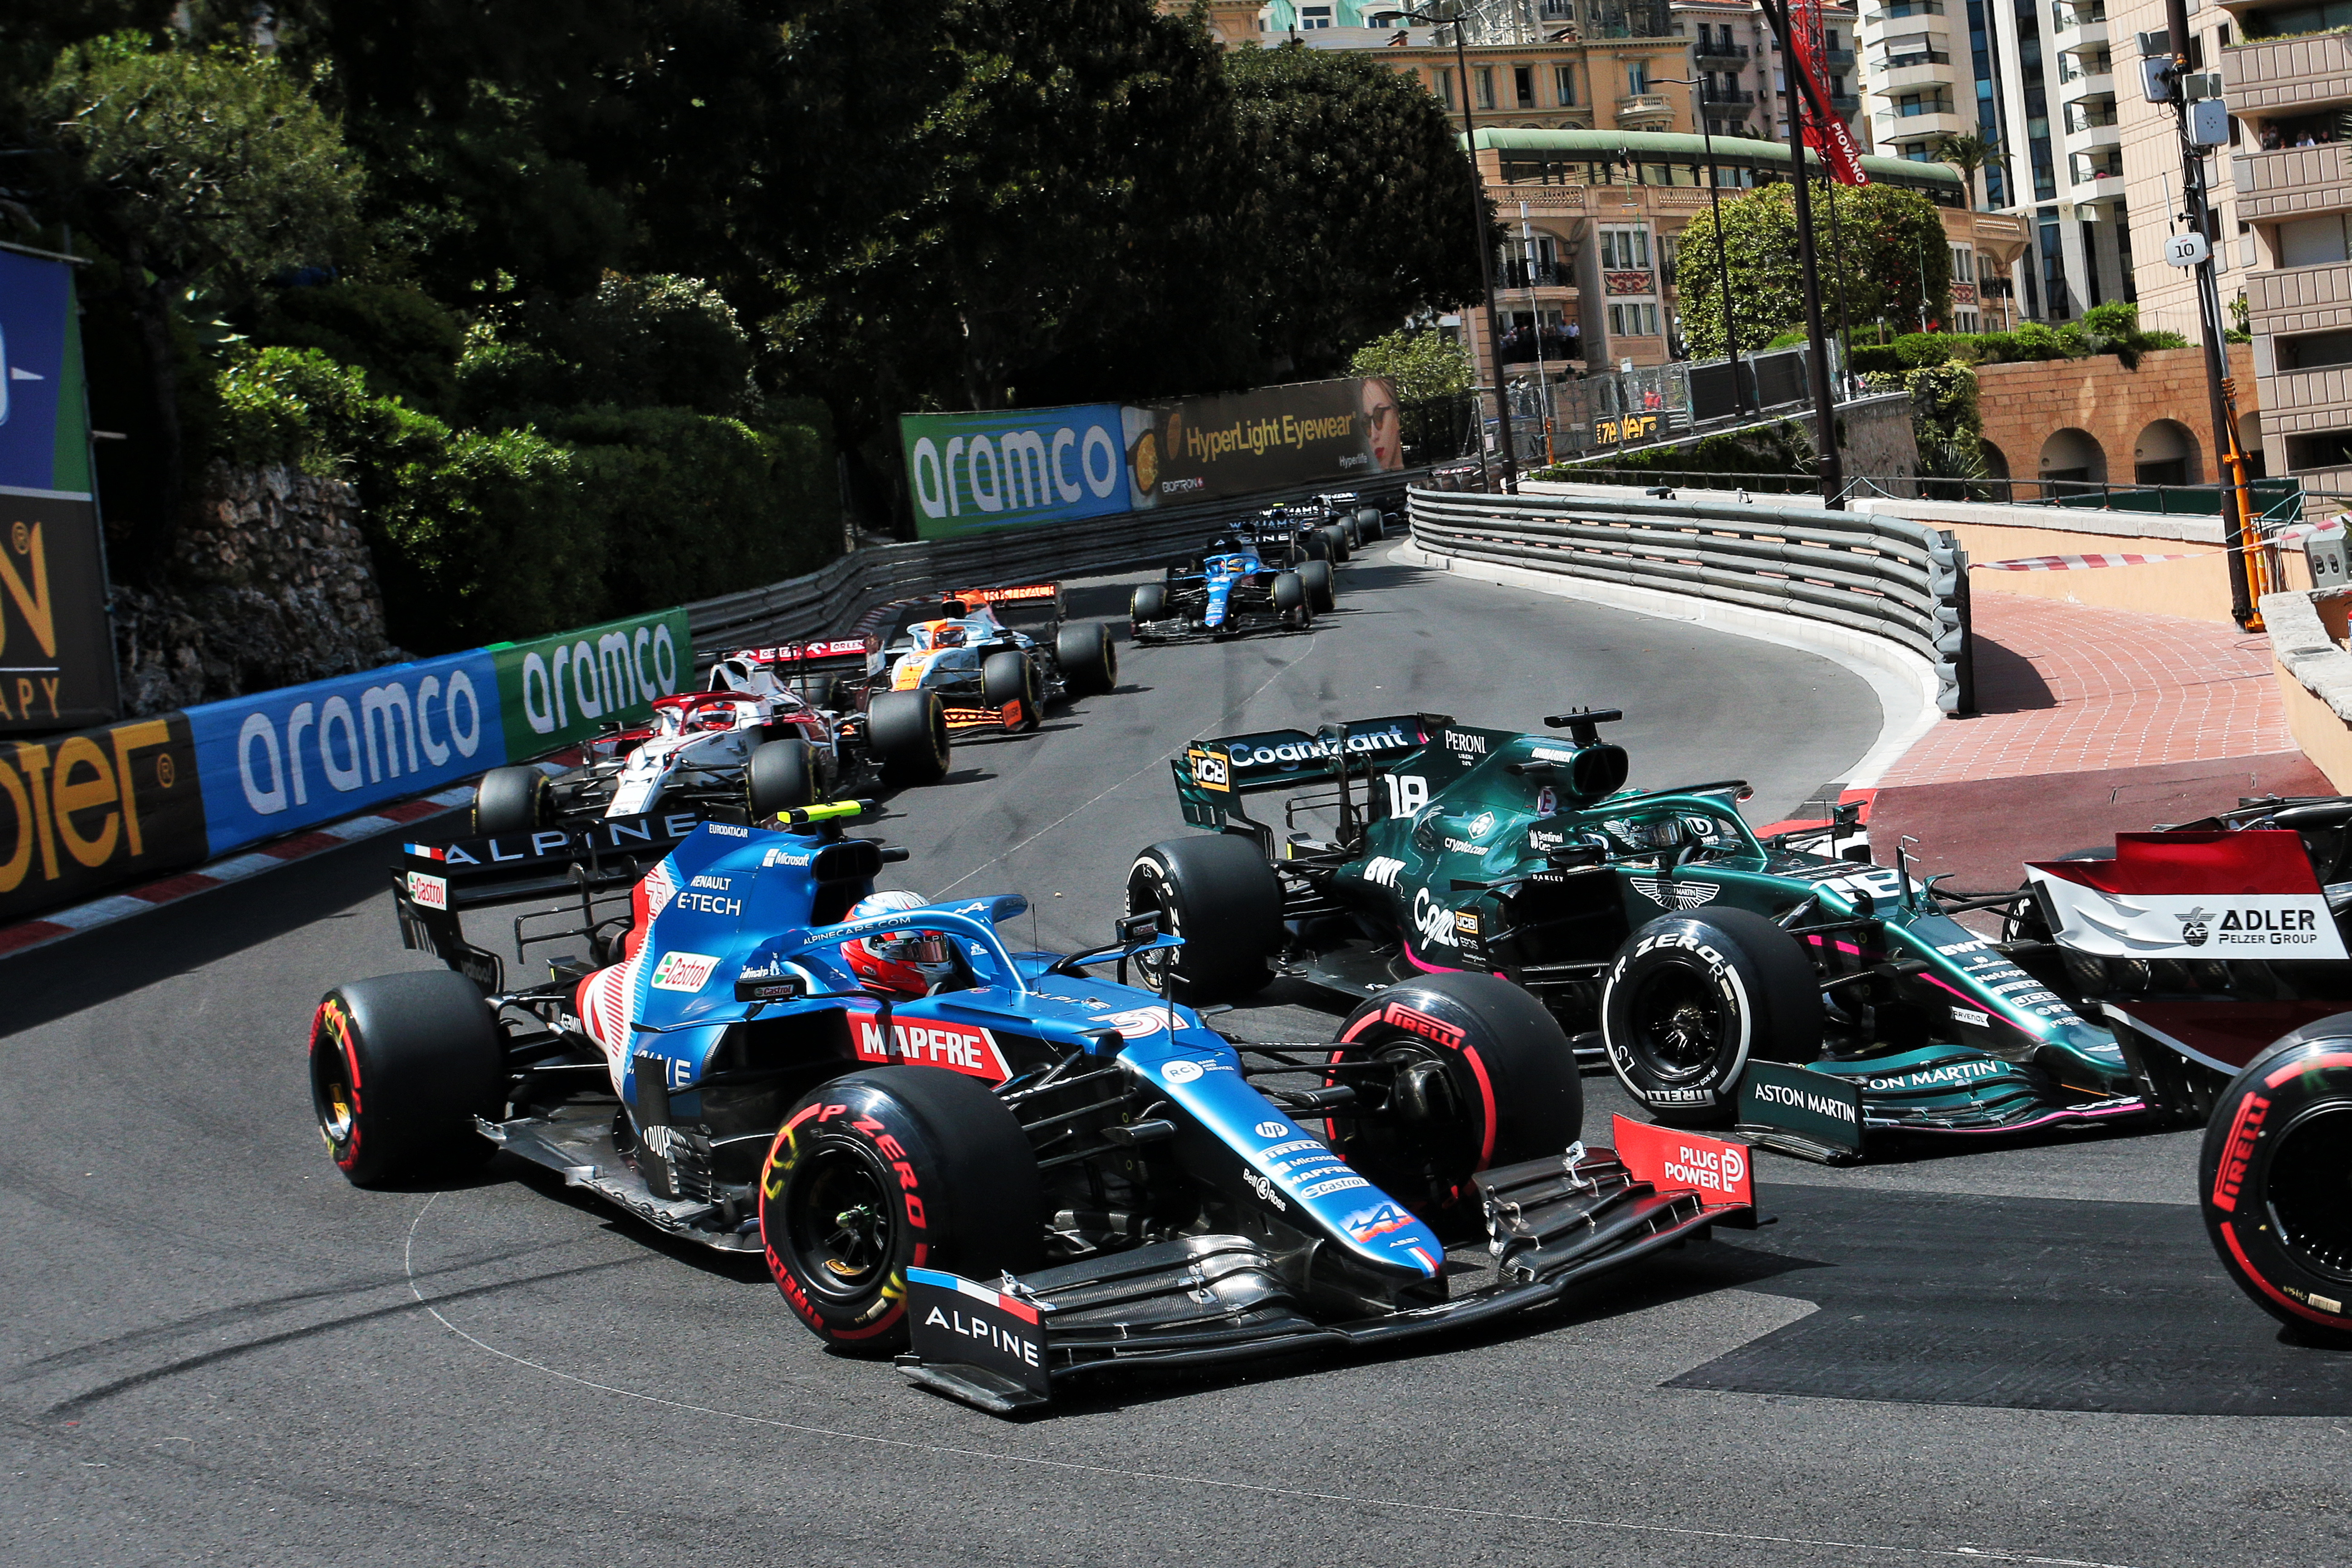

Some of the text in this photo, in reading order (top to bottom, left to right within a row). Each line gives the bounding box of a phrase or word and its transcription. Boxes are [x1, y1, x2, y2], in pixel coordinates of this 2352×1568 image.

[1832, 122, 1866, 183] PIOVANO
[2176, 243, 2194, 258] 10
[1186, 414, 1352, 462] HyperLight Eyewear
[914, 425, 1116, 518] aramco
[523, 623, 676, 734] aramco
[238, 670, 479, 815] aramco
[1229, 725, 1408, 770] Cognizant
[1445, 730, 1487, 754] PERONI
[1531, 746, 1572, 763] BOMBARDIER
[1194, 758, 1226, 784] JCB
[1384, 774, 1429, 819] 18
[446, 815, 698, 864] ALPINE
[708, 823, 749, 838] EURODATACAR
[1538, 831, 1563, 843] Sentinel
[774, 853, 809, 867] Microsoft
[1444, 837, 1490, 857] crypto.com
[690, 875, 731, 891] RENAULT
[1364, 856, 1406, 888] BWT
[1532, 874, 1563, 882] OAKLEY
[416, 879, 444, 905] Castrol
[677, 892, 741, 916] E-TECH
[1676, 887, 1696, 897] MARTIN
[804, 916, 911, 946] ALPINECARS.COM
[1457, 916, 1476, 930] JCB
[2219, 910, 2317, 930] ADLER
[1635, 933, 1724, 964] ZERO
[1935, 940, 1988, 956] BWT
[666, 956, 709, 987] Castrol
[1975, 969, 2028, 984] NetApp
[763, 985, 792, 995] Castrol
[2047, 1004, 2073, 1013] IFS
[1086, 1005, 1191, 1040] 31
[1384, 1002, 1466, 1050] PIRELLI
[861, 1022, 983, 1069] MAPFRE
[1911, 1060, 1998, 1086] MARTIN
[1646, 1089, 1716, 1108] PIRELLI
[1754, 1082, 1856, 1125] ASTON MARTIN
[1260, 1122, 1282, 1138] hp
[1680, 1146, 1719, 1171] PLUG
[2212, 1091, 2271, 1212] PIRELLI
[818, 1104, 926, 1229] P ZERO
[1286, 1166, 1357, 1188] MAPFRE
[1664, 1161, 1720, 1191] POWER
[1243, 1168, 1258, 1187] Bell
[1268, 1190, 1286, 1211] Ross
[1319, 1178, 1366, 1193] Castrol
[765, 1244, 824, 1330] PIRELLI
[925, 1306, 1039, 1367] ALPINE
